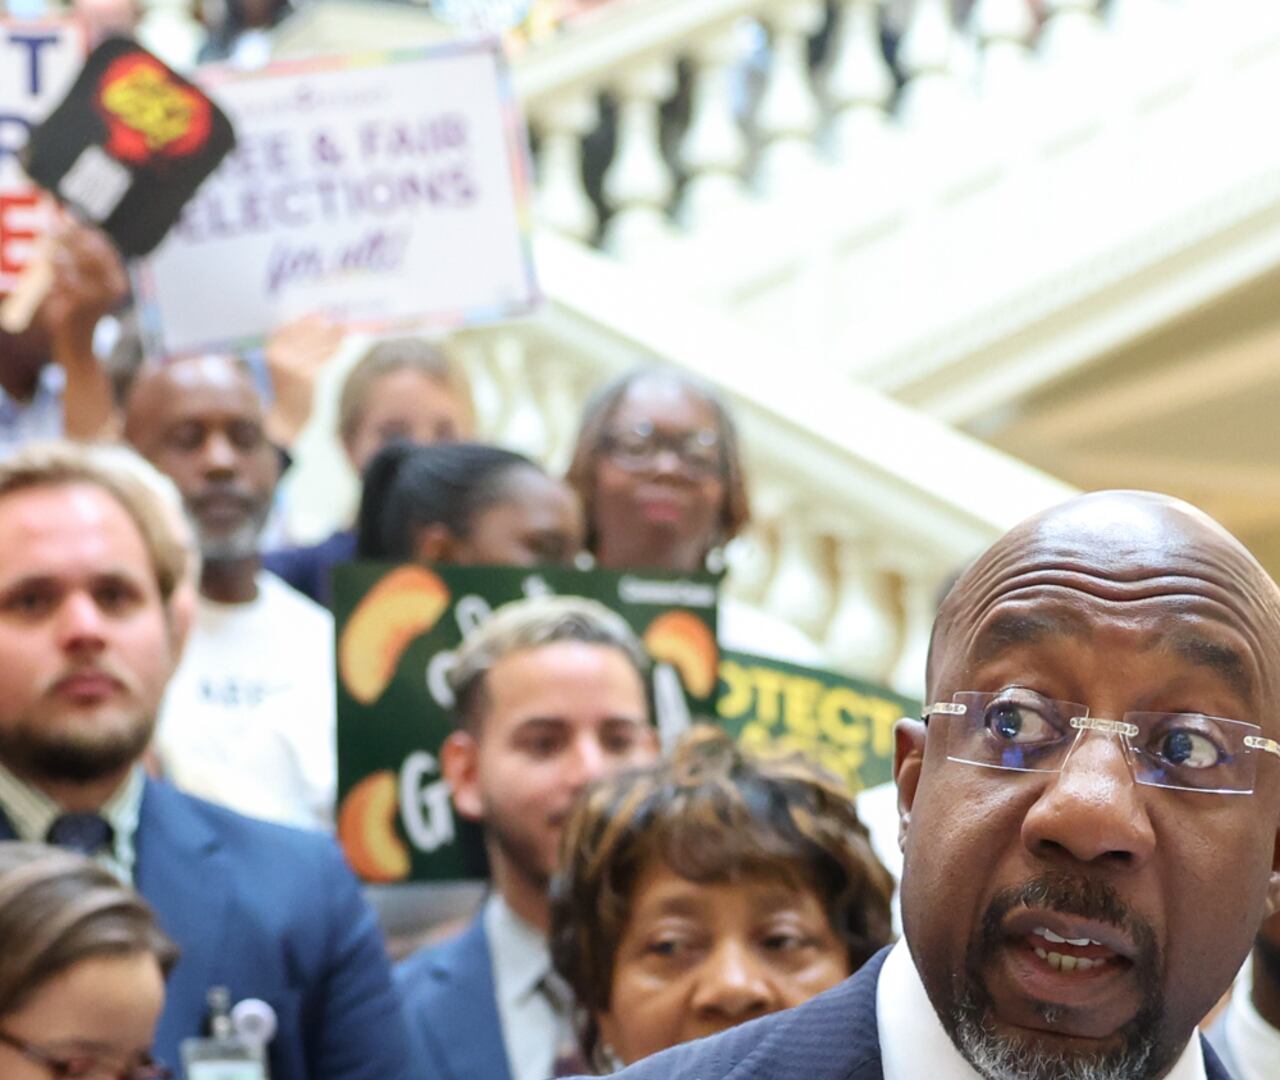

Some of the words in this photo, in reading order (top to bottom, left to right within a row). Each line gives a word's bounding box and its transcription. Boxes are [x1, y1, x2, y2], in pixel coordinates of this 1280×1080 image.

[313, 129, 346, 167] &
[359, 114, 470, 159] FAIR
[176, 165, 479, 244] ELECTIONS
